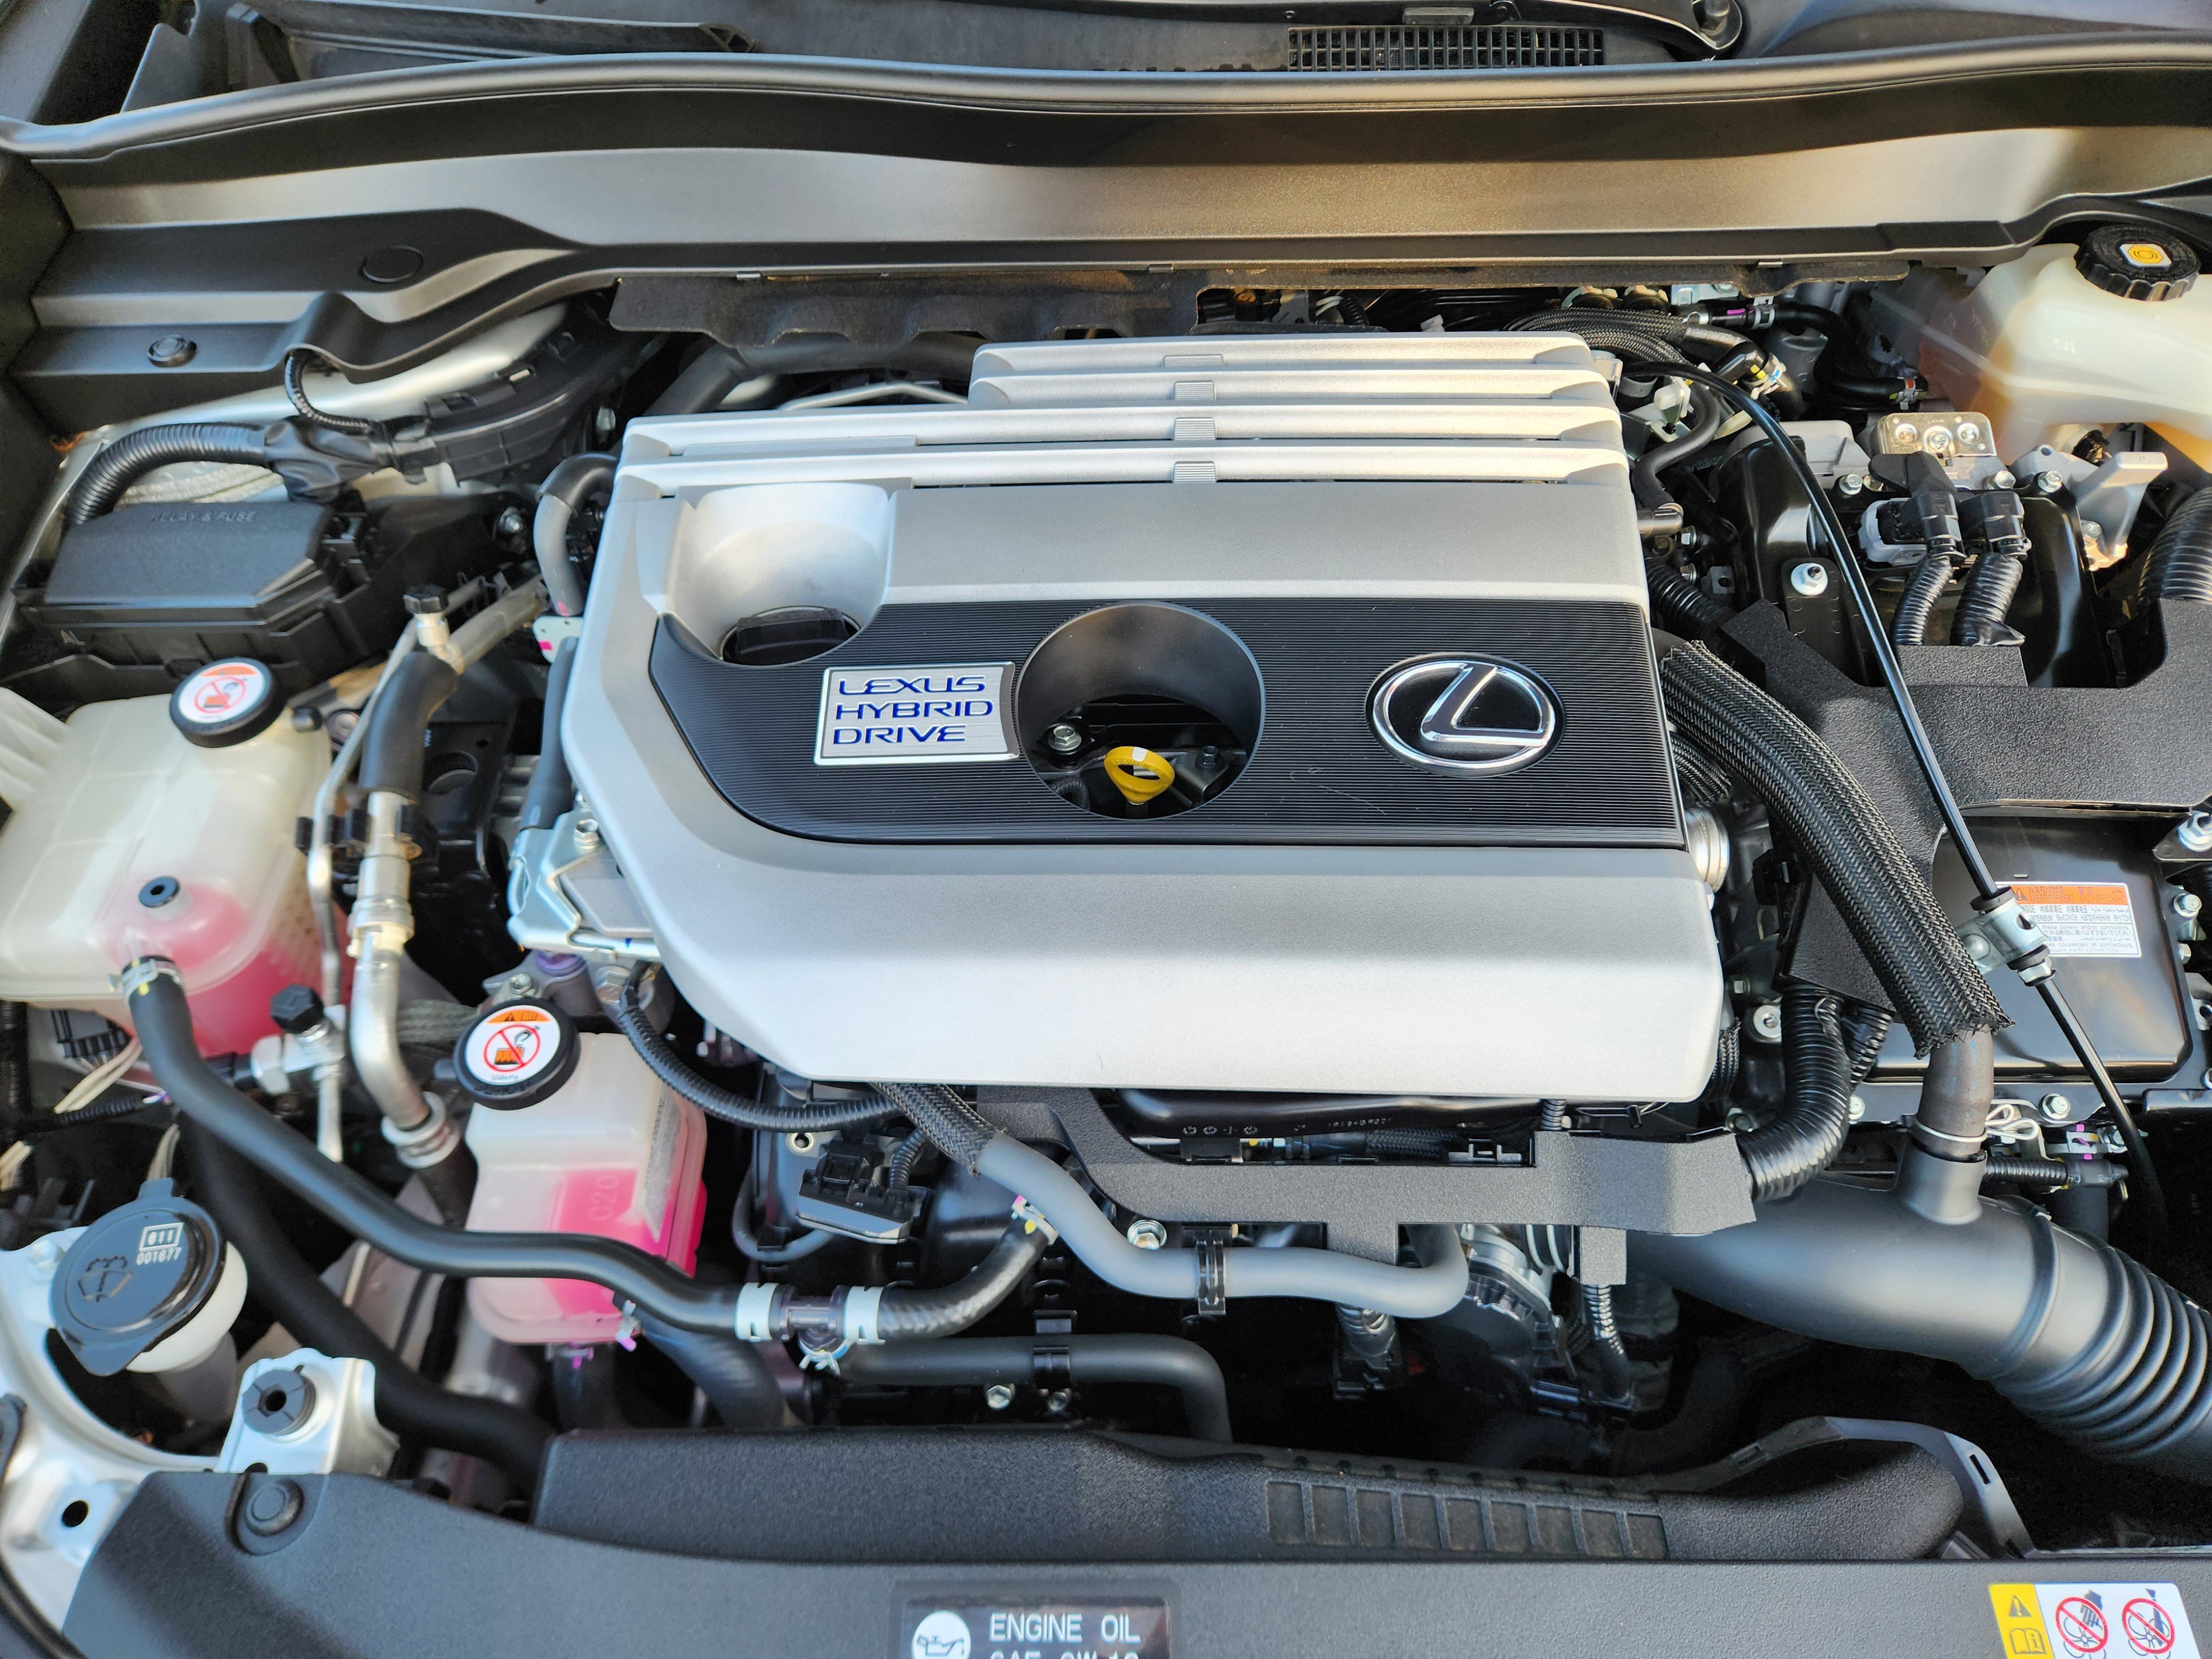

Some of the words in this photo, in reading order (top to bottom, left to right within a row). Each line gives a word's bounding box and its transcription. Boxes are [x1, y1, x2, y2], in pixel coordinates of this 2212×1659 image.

[838, 674, 987, 696] LEXUS
[835, 699, 994, 720] HYBRID
[832, 723, 968, 745] DRIVE
[2027, 886, 2064, 894] WARNING
[2029, 894, 2074, 903] AVERTISSEMENT
[137, 1247, 182, 1265] 001677
[989, 1612, 1083, 1644] ENGINE
[1100, 1612, 1142, 1644] OIL
